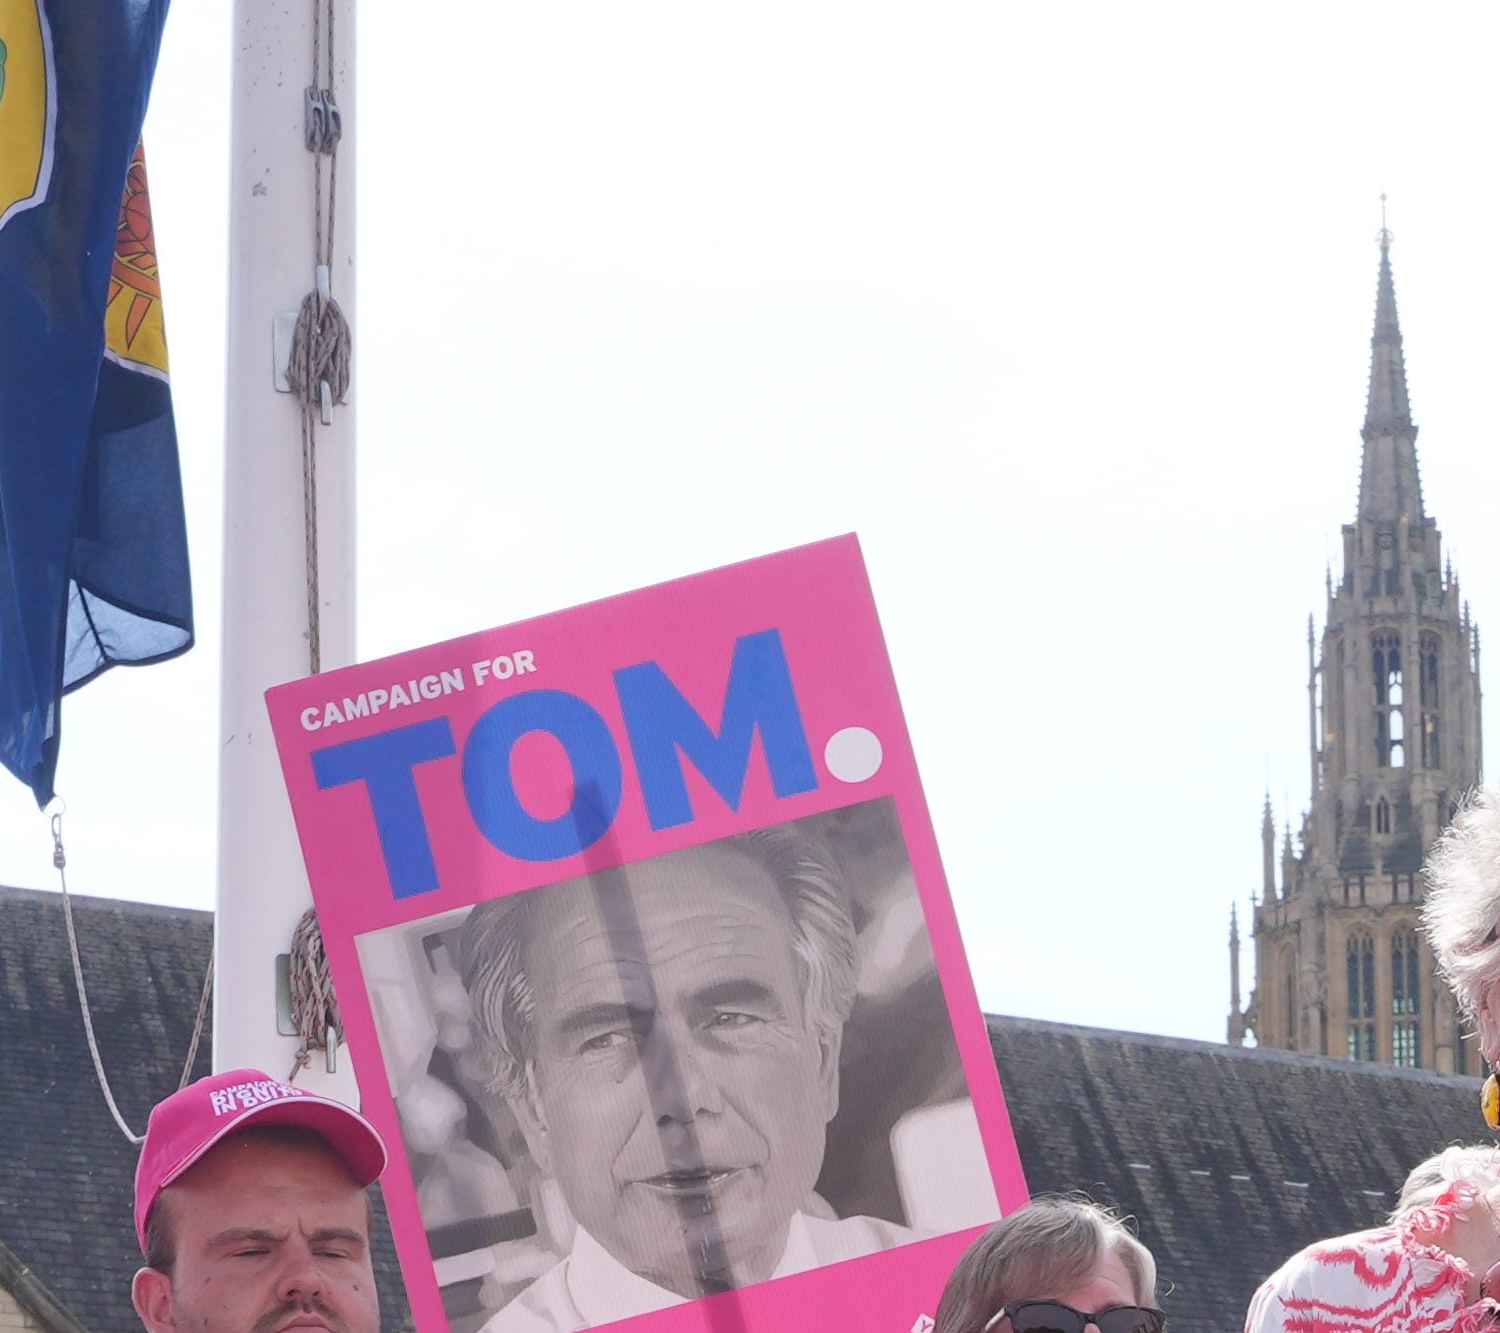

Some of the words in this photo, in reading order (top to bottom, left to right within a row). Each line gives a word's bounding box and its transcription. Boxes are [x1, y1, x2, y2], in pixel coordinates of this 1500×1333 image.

[300, 666, 465, 734] CAMPAIGN
[472, 649, 537, 690] FOR
[309, 627, 884, 901] TOM.
